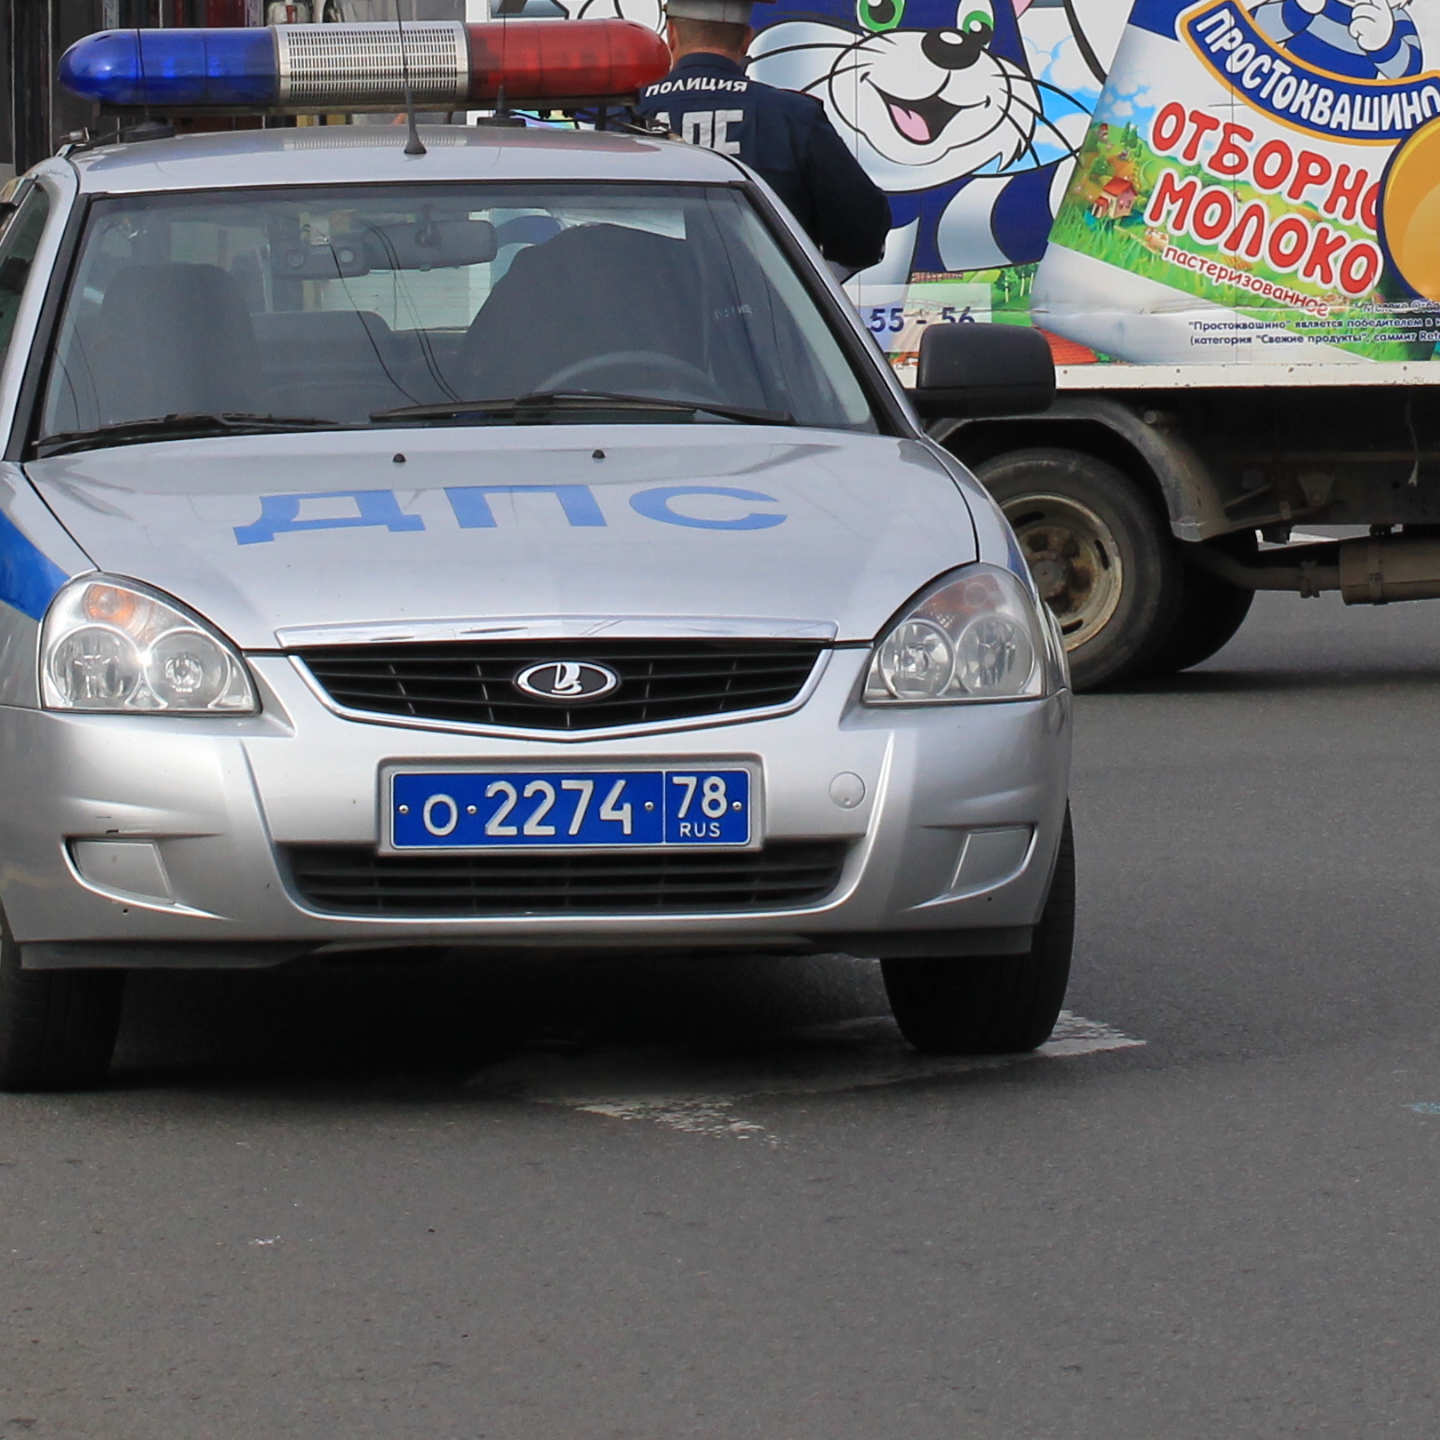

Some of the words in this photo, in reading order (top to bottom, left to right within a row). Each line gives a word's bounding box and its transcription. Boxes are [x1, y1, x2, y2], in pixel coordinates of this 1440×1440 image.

[645, 77, 748, 98] ПОЛИЦИЯ
[1149, 172, 1380, 295] МОЛОКО
[1164, 245, 1330, 317] пастеризованное
[1188, 320, 1291, 333] "Простоквашино"
[1294, 320, 1343, 329] является
[1346, 317, 1422, 329] победителем
[1425, 318, 1432, 326] в
[1190, 335, 1252, 347] (категория
[1255, 334, 1304, 344] "Свежие
[1373, 332, 1417, 342] саммит
[232, 484, 788, 545] ДПС
[671, 775, 728, 820] 78
[679, 821, 721, 839] RUS
